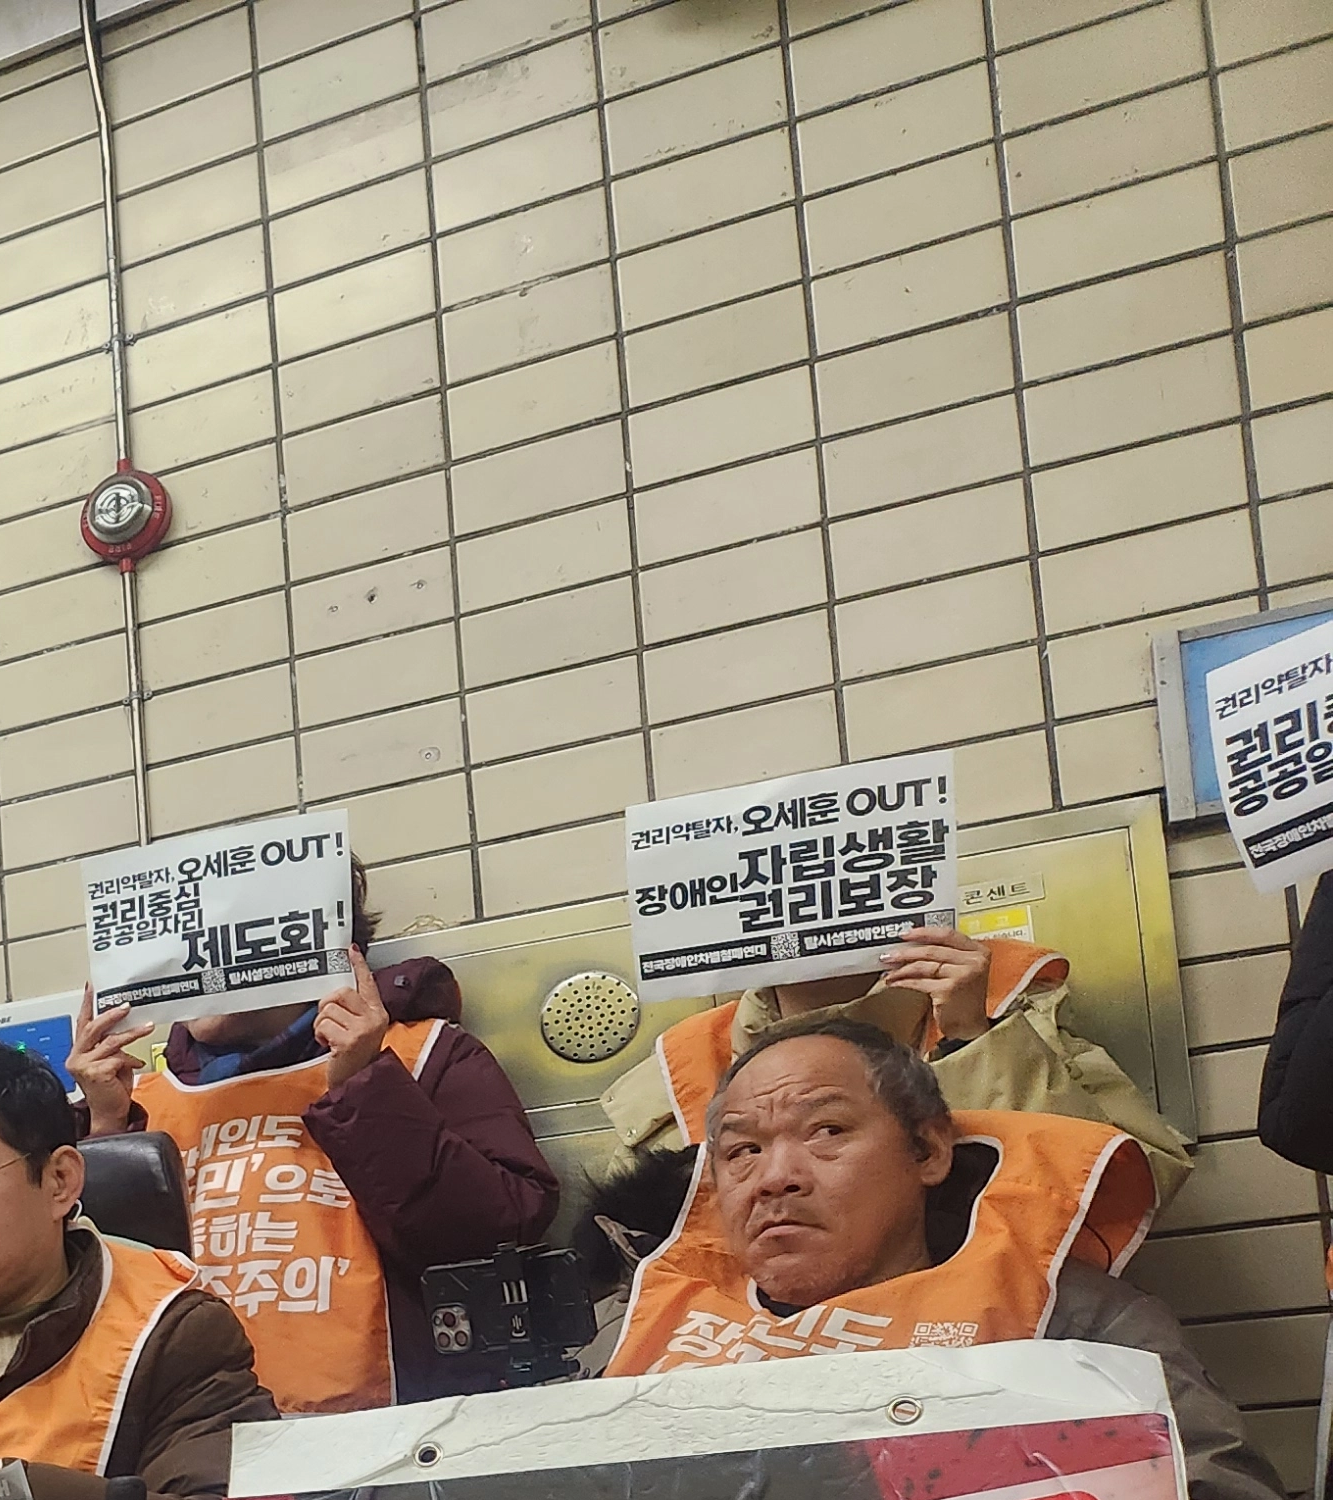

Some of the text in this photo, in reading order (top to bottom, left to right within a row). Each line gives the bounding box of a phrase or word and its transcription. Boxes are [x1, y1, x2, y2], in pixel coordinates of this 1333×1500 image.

[1226, 693, 1333, 774] 권리
[631, 775, 947, 850] 권리약탈자, 오세훈 OUT!
[88, 831, 344, 901] 권리약탈자, 오세훈 OUT!
[738, 818, 950, 890] 자립생활
[92, 883, 202, 929] 권리중심
[635, 872, 738, 917] 장애인
[738, 864, 938, 934] 권리보장
[962, 882, 1031, 905] 콘센트
[92, 908, 204, 951] 공공일자리
[642, 942, 768, 974] 전국장애인차별철폐연대
